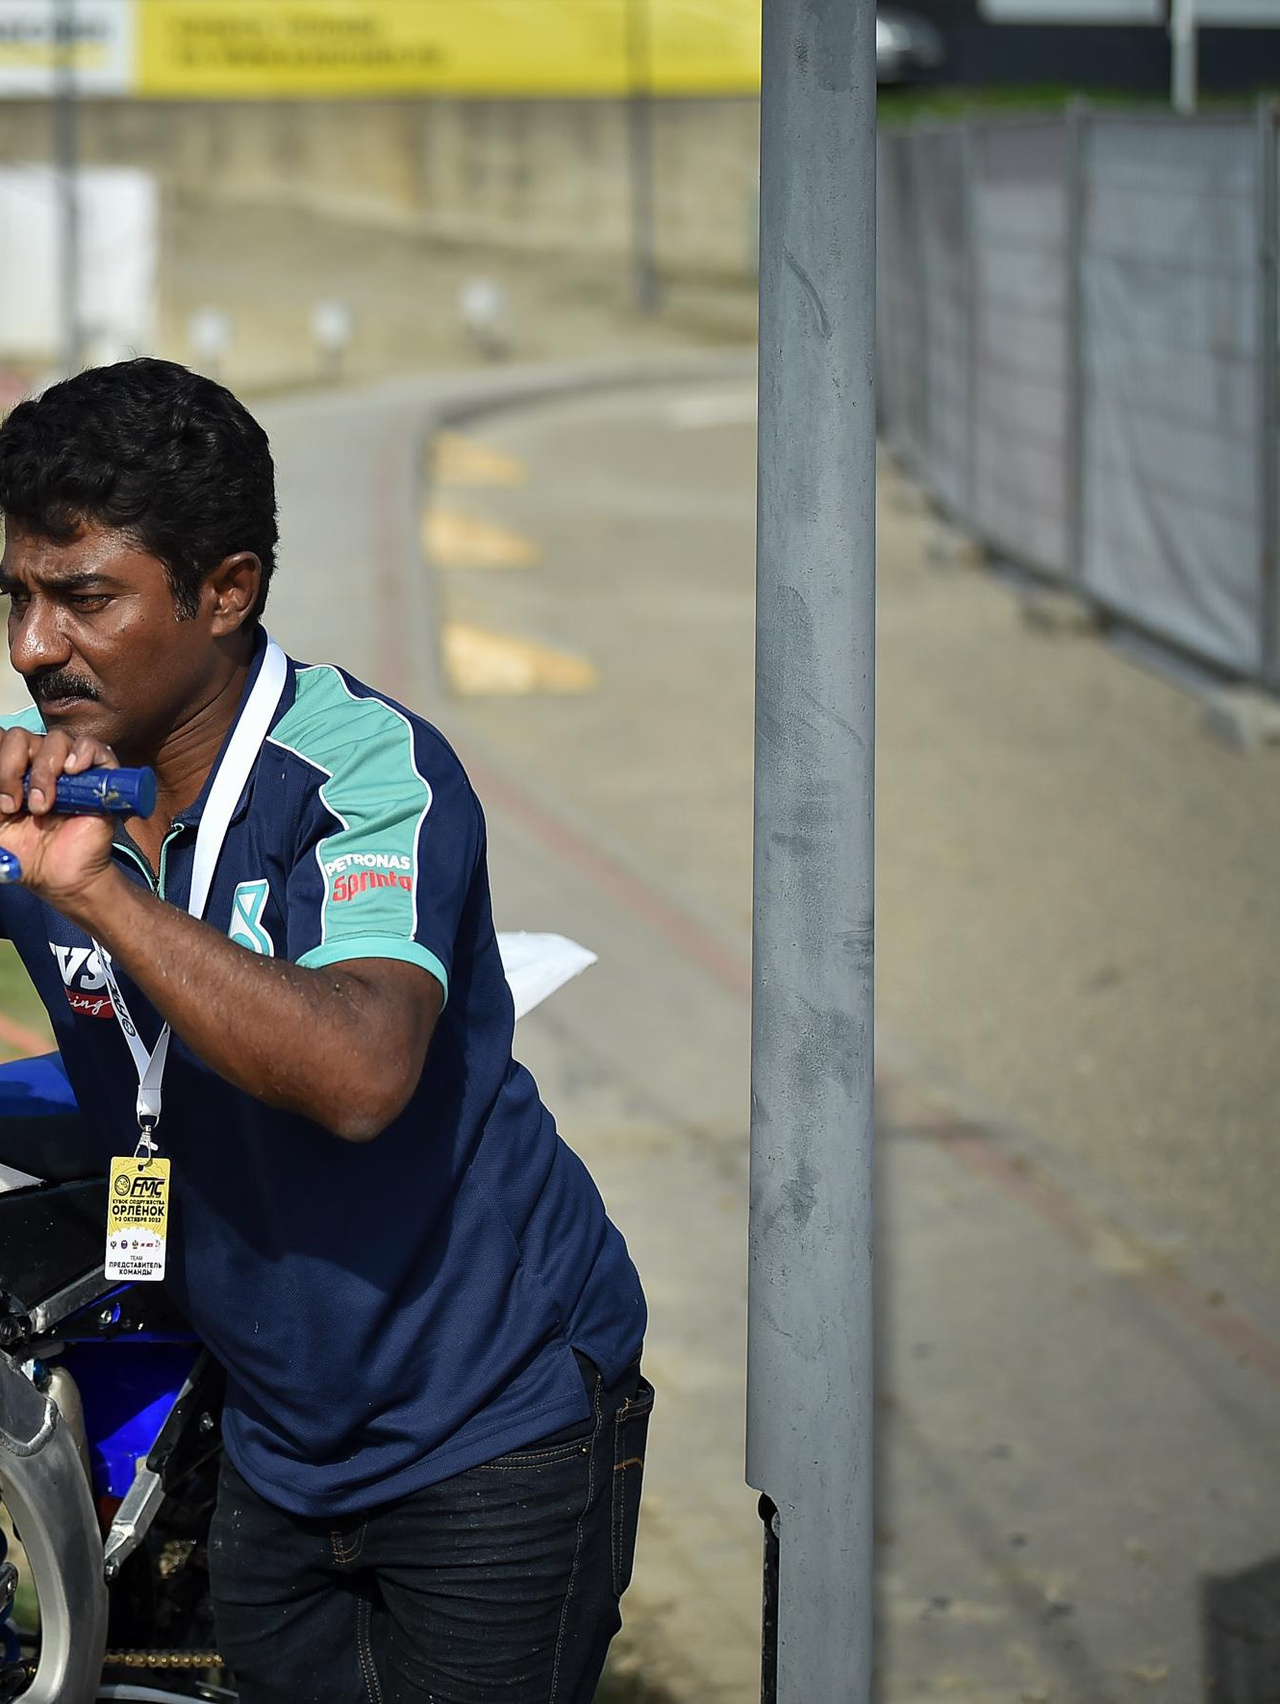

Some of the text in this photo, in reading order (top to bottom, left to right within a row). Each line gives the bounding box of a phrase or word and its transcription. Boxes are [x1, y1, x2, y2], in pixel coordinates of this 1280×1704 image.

[324, 853, 411, 877] PETRONAS
[130, 1177, 166, 1196] FMC
[112, 1205, 165, 1216] ОРЛЁНОК
